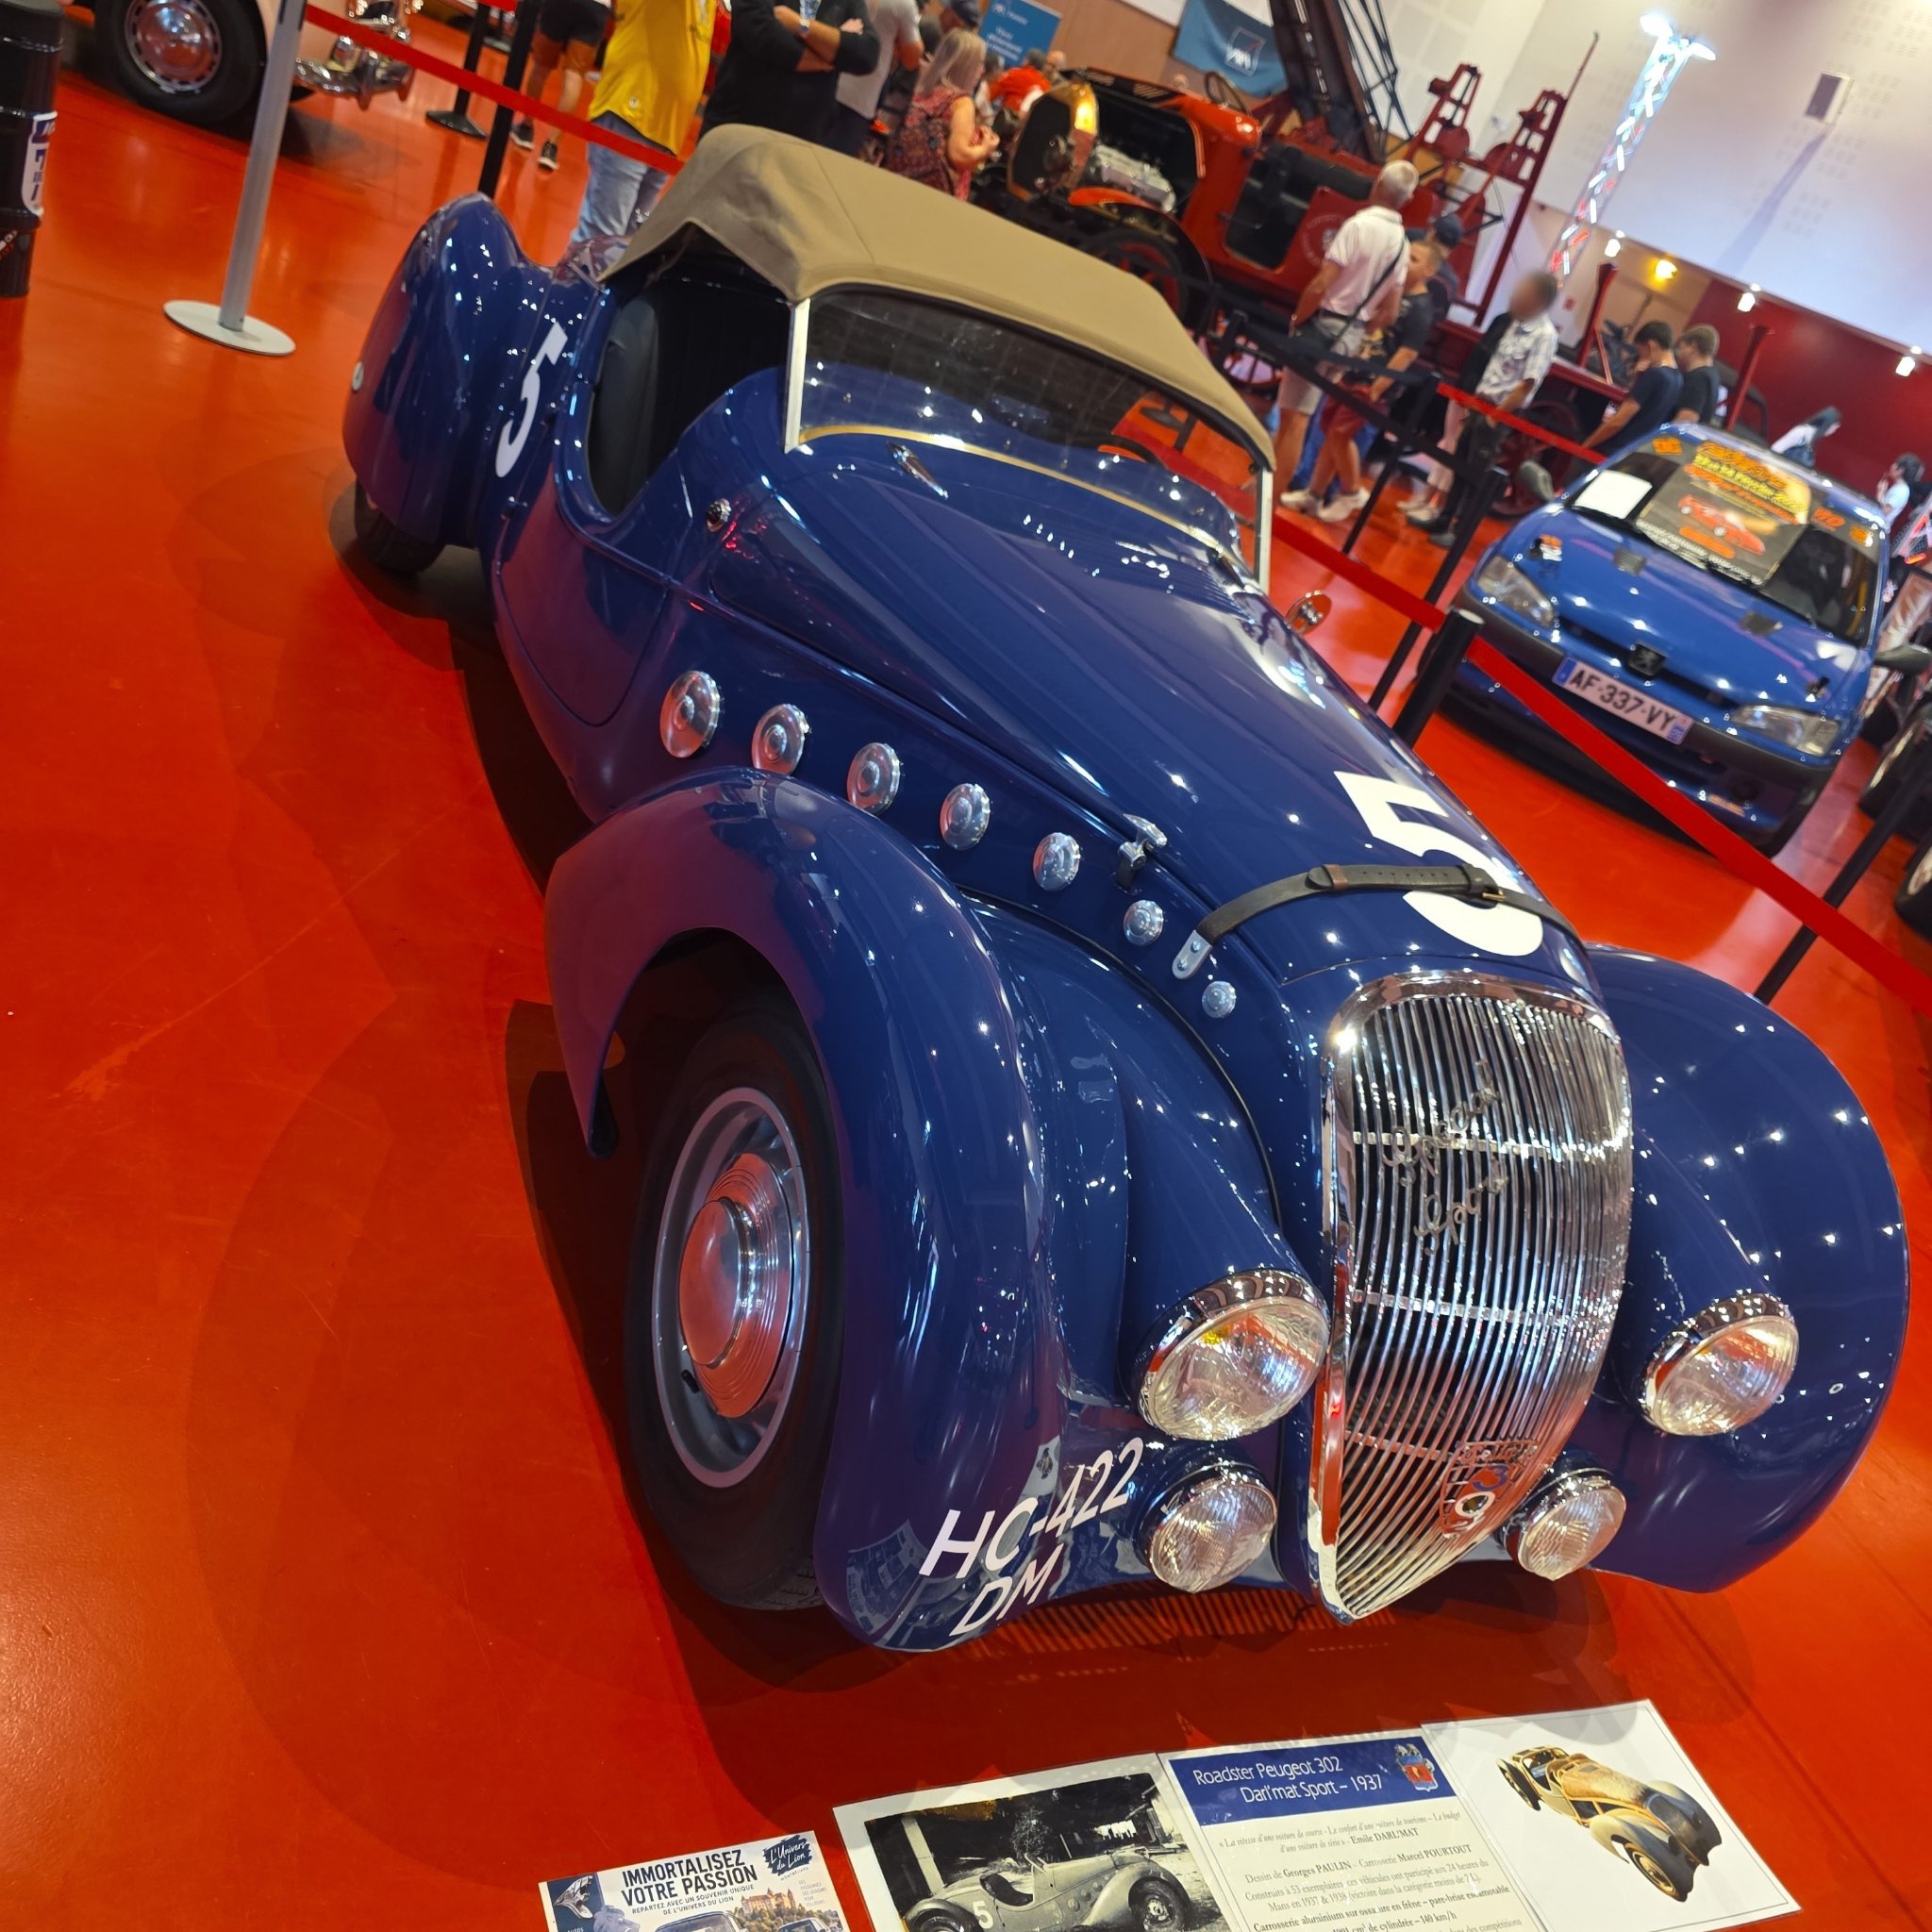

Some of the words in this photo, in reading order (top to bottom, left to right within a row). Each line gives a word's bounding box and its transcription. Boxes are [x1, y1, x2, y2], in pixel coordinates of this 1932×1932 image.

[495, 322, 568, 477] 5
[1570, 670, 1677, 731] AF-337-VY
[1334, 771, 1543, 957] 5
[919, 1437, 1143, 1579] HC-422
[949, 1542, 1064, 1637] DM
[1192, 1766, 1254, 1785] Roadster
[1256, 1760, 1314, 1780] Peugeot
[1313, 1756, 1343, 1774] 302
[1301, 1781, 1339, 1801] Sport
[1350, 1774, 1383, 1791] 1937
[1298, 1829, 1304, 1838] de
[1396, 1817, 1403, 1825] de
[1320, 1840, 1326, 1848] de
[1350, 1834, 1374, 1844] Emile
[622, 1849, 745, 1888] IMMORTALISEZ
[770, 1841, 807, 1864] L'Univers
[776, 1859, 786, 1870] du
[788, 1853, 806, 1868] Lion
[1245, 1872, 1273, 1883] Dessin
[1274, 1870, 1283, 1879] de
[1283, 1868, 1315, 1877] Georges
[1315, 1860, 1352, 1874] PAULIN
[1358, 1857, 1397, 1867] Carrosserie
[1397, 1850, 1424, 1862] Marcel
[1424, 1844, 1472, 1858] POURTOUT
[621, 1880, 677, 1907] VOTRE
[681, 1864, 758, 1895] PASSION
[1245, 1888, 1284, 1901] Construits
[1291, 1884, 1301, 1894] 53
[1346, 1878, 1357, 1887] ces
[1358, 1873, 1391, 1885] véhicules
[1404, 1867, 1434, 1881] participé
[1446, 1863, 1457, 1872] 24
[1456, 1861, 1479, 1870] heures
[1479, 1858, 1489, 1867] du
[1268, 1902, 1291, 1912] Mans
[1301, 1896, 1320, 1907] 1937
[1378, 1887, 1395, 1896] dans
[1392, 1885, 1403, 1893] la
[1403, 1881, 1434, 1892] catégorie
[1434, 1878, 1455, 1887] moins
[1456, 1875, 1464, 1884] de
[632, 1903, 664, 1914] REPARTEZ
[667, 1899, 684, 1907] AVEC
[696, 1890, 728, 1901] SOUVENIR
[729, 1884, 754, 1894] UNIQUE
[674, 1903, 706, 1914] L'UNIVERS
[973, 1900, 993, 1929] 5
[1254, 1918, 1300, 1932] Carrosserie
[1301, 1912, 1344, 1924] aluminium
[1345, 1909, 1358, 1918] sur
[1402, 1900, 1422, 1909] frêne
[1428, 1893, 1464, 1907] pare-brise
[1379, 1918, 1413, 1932] cylindrée
[1420, 1913, 1433, 1924] 140
[1433, 1910, 1457, 1922] km/h
